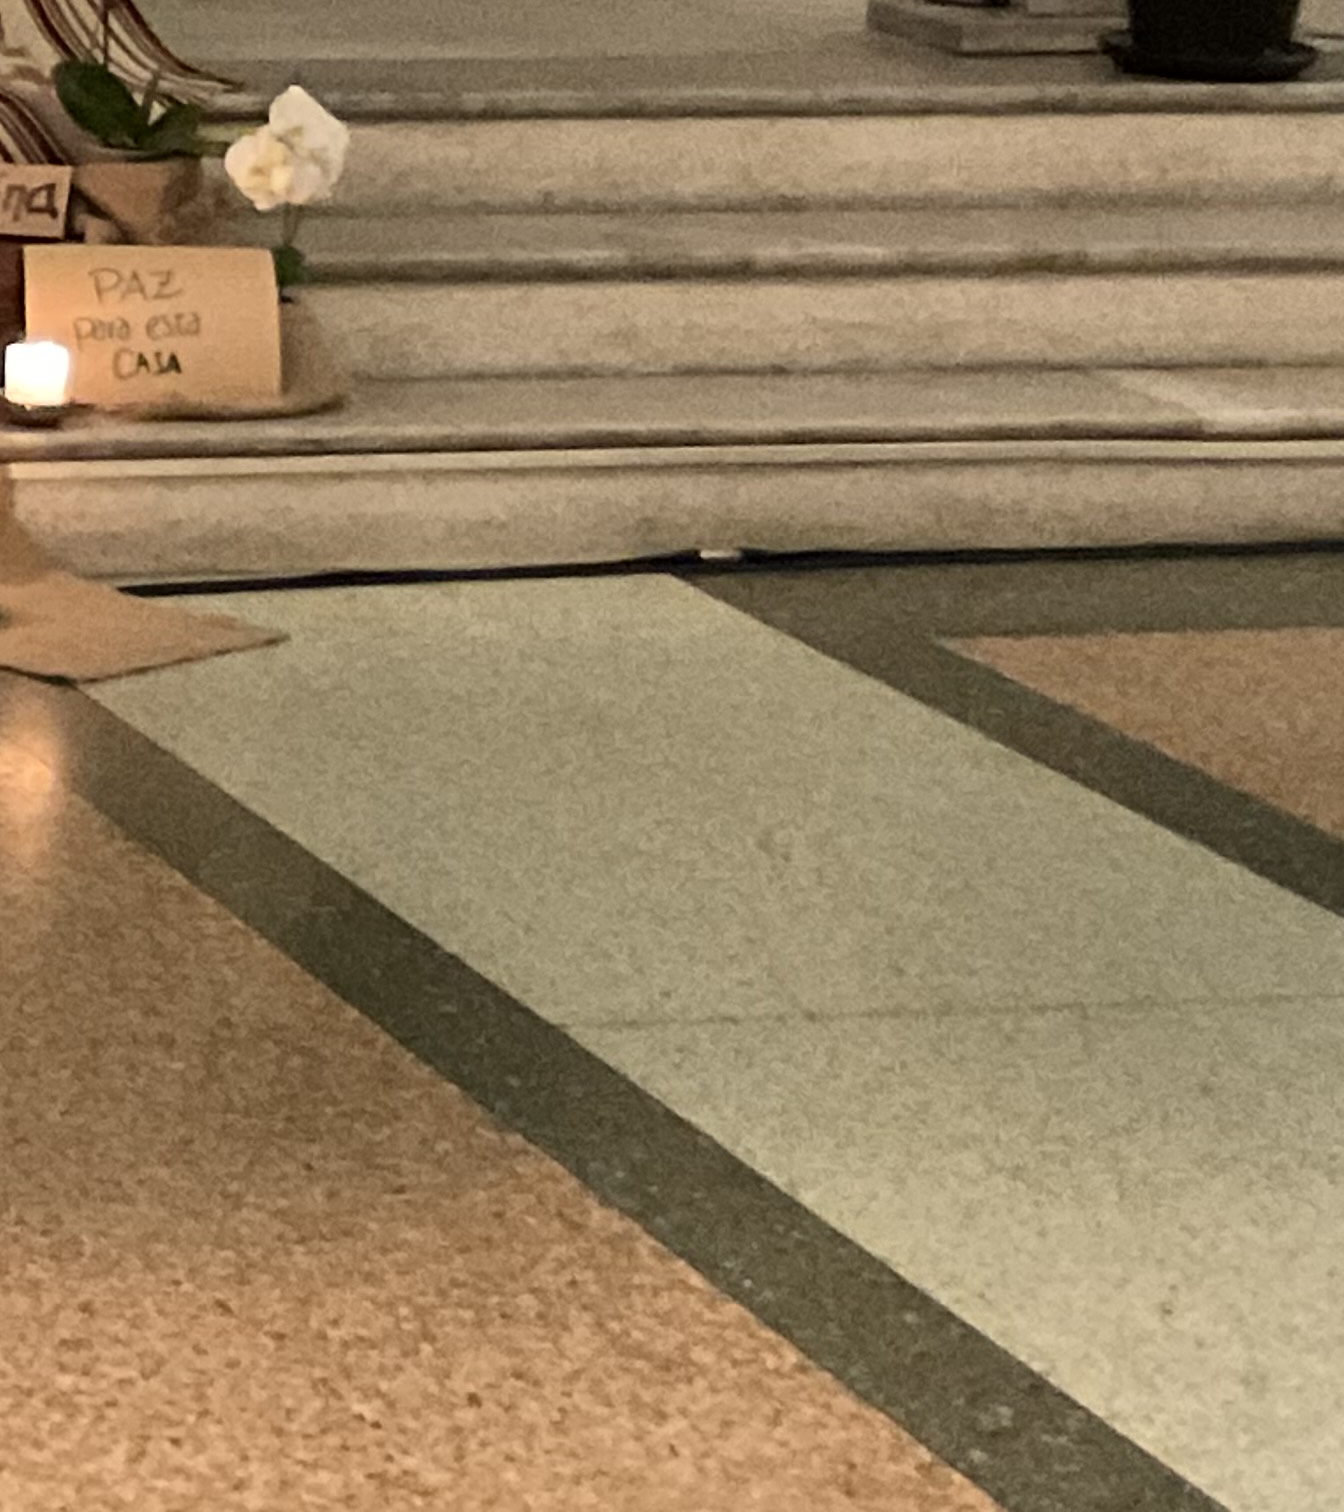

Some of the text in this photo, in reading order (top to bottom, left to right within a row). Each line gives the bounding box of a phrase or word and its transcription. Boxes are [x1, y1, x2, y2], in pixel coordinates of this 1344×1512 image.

[87, 266, 185, 304] PAZ
[144, 311, 202, 342] esta
[111, 346, 184, 381] CASA
